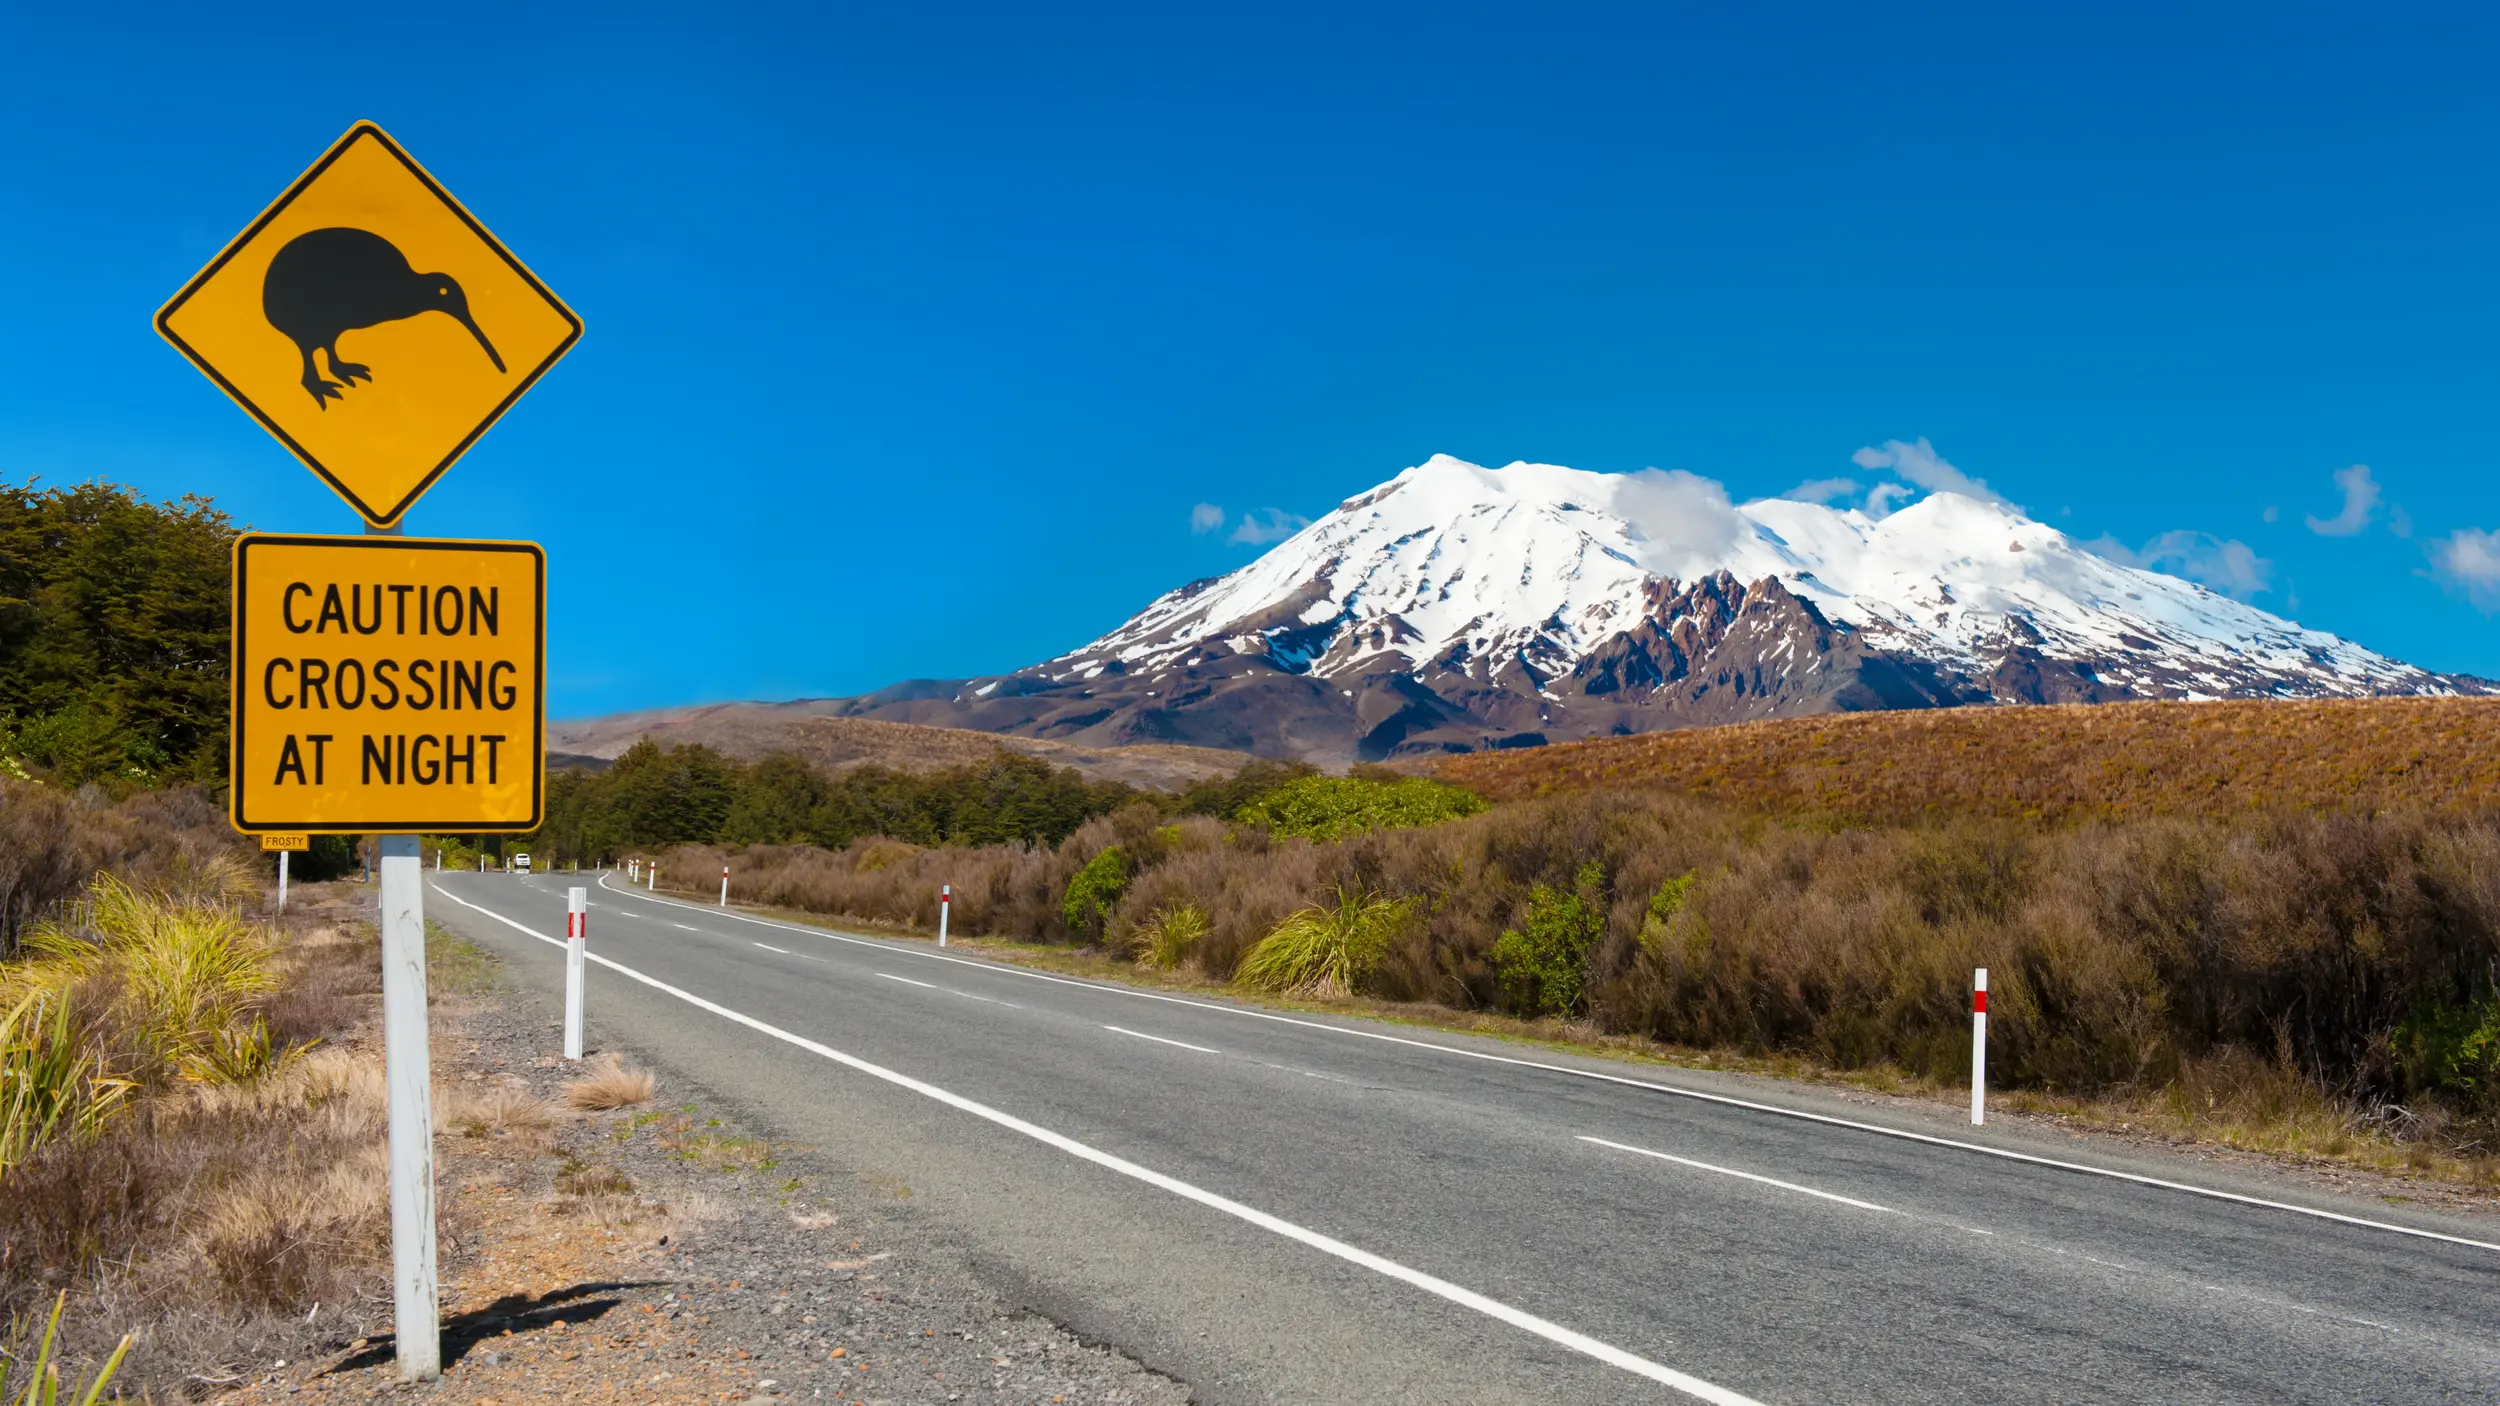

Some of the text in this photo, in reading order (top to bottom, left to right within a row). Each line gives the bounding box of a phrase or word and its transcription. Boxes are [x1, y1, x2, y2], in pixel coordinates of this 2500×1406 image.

[283, 581, 499, 637] CAUTION
[264, 657, 517, 711] CROSSING
[274, 734, 506, 786] AT NIGHT
[265, 836, 304, 846] FROSTY
